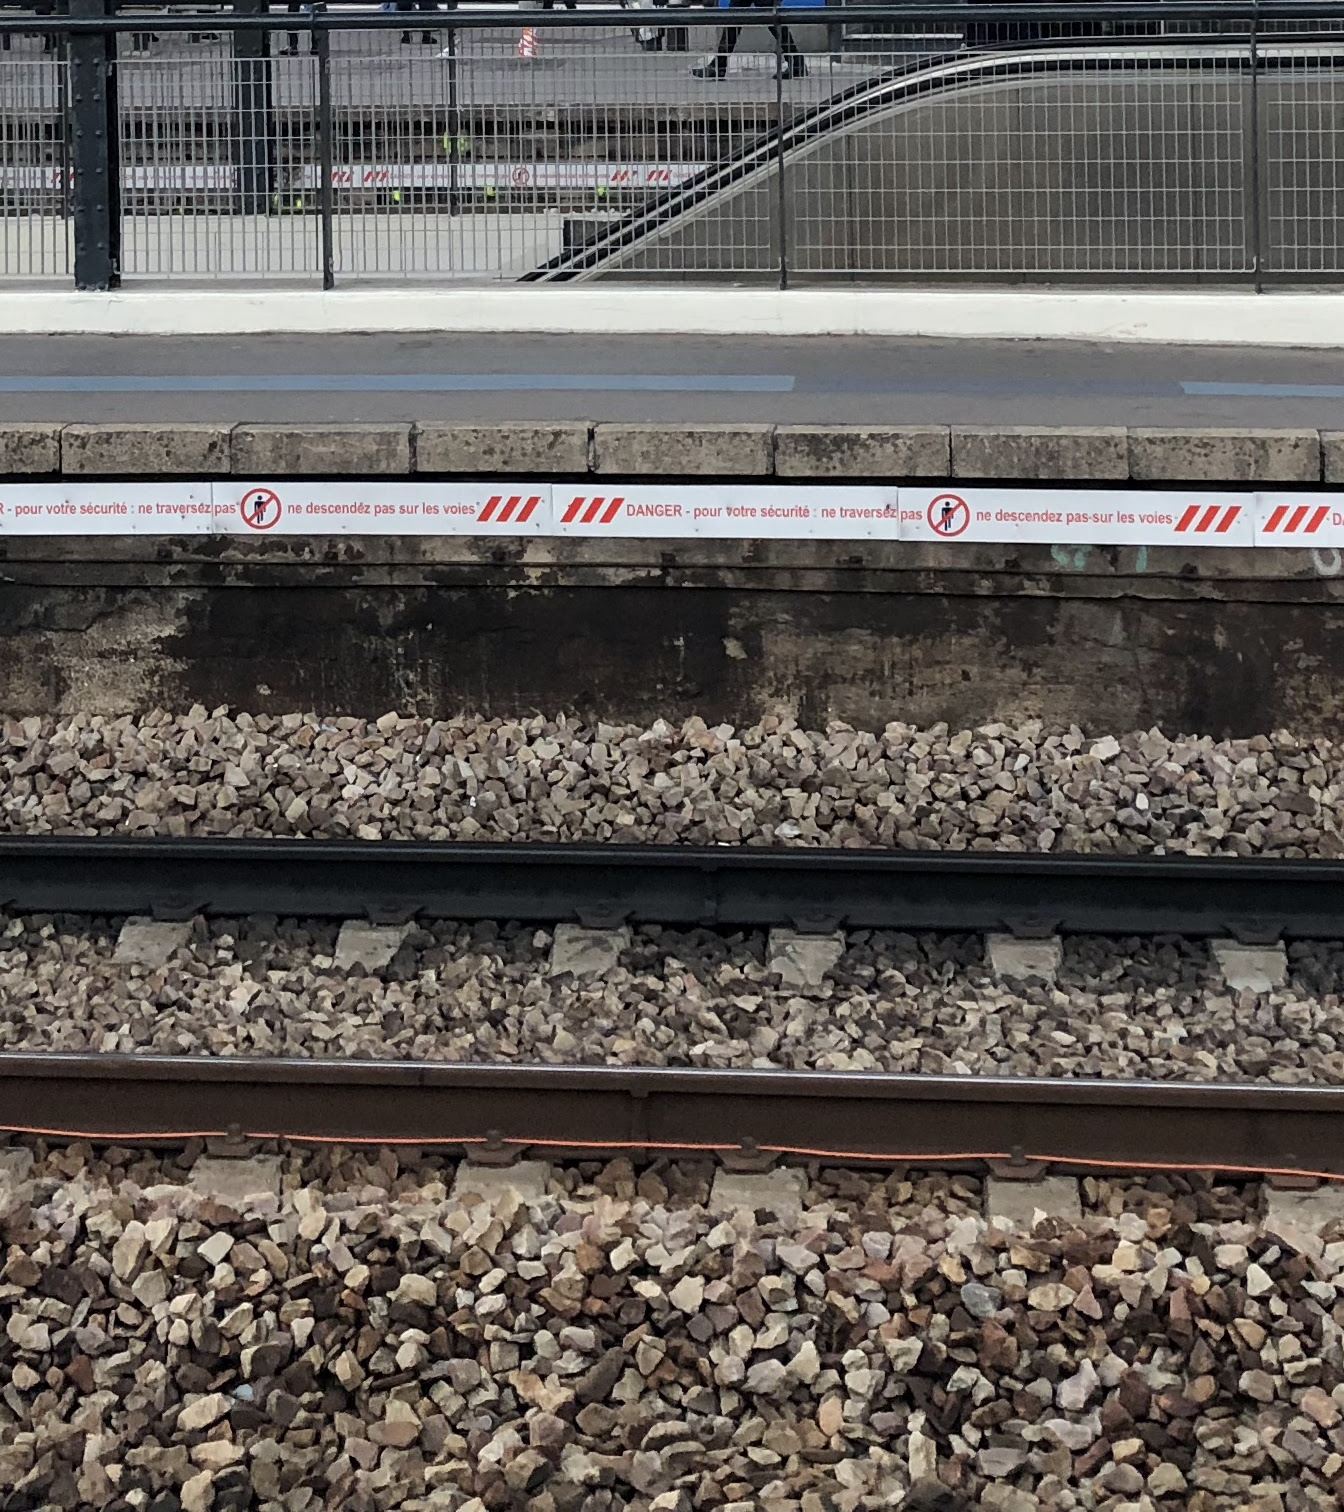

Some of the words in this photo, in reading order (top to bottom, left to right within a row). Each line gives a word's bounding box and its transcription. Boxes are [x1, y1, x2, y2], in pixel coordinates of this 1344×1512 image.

[15, 505, 43, 517] pour
[47, 503, 76, 514] votre
[80, 502, 127, 514] sécurité
[138, 505, 152, 514] ne
[156, 502, 211, 514] traversez
[213, 504, 236, 516] pas
[288, 505, 302, 514] ne
[306, 502, 370, 514] descendez
[374, 505, 395, 517] pas
[399, 505, 419, 514] sur
[423, 502, 439, 514] les
[443, 502, 475, 514] voies
[627, 504, 682, 517] DANGER
[694, 508, 722, 520] pour
[726, 505, 756, 517] votre
[761, 505, 810, 518] sécurité
[822, 509, 836, 518] ne
[840, 506, 897, 518] traversez
[901, 511, 922, 523] pas
[977, 512, 991, 521] ne
[995, 509, 1062, 522] descendez
[1066, 513, 1089, 525] pas
[1090, 513, 1112, 523] sur
[1117, 511, 1135, 523] les
[1139, 511, 1172, 524] voies
